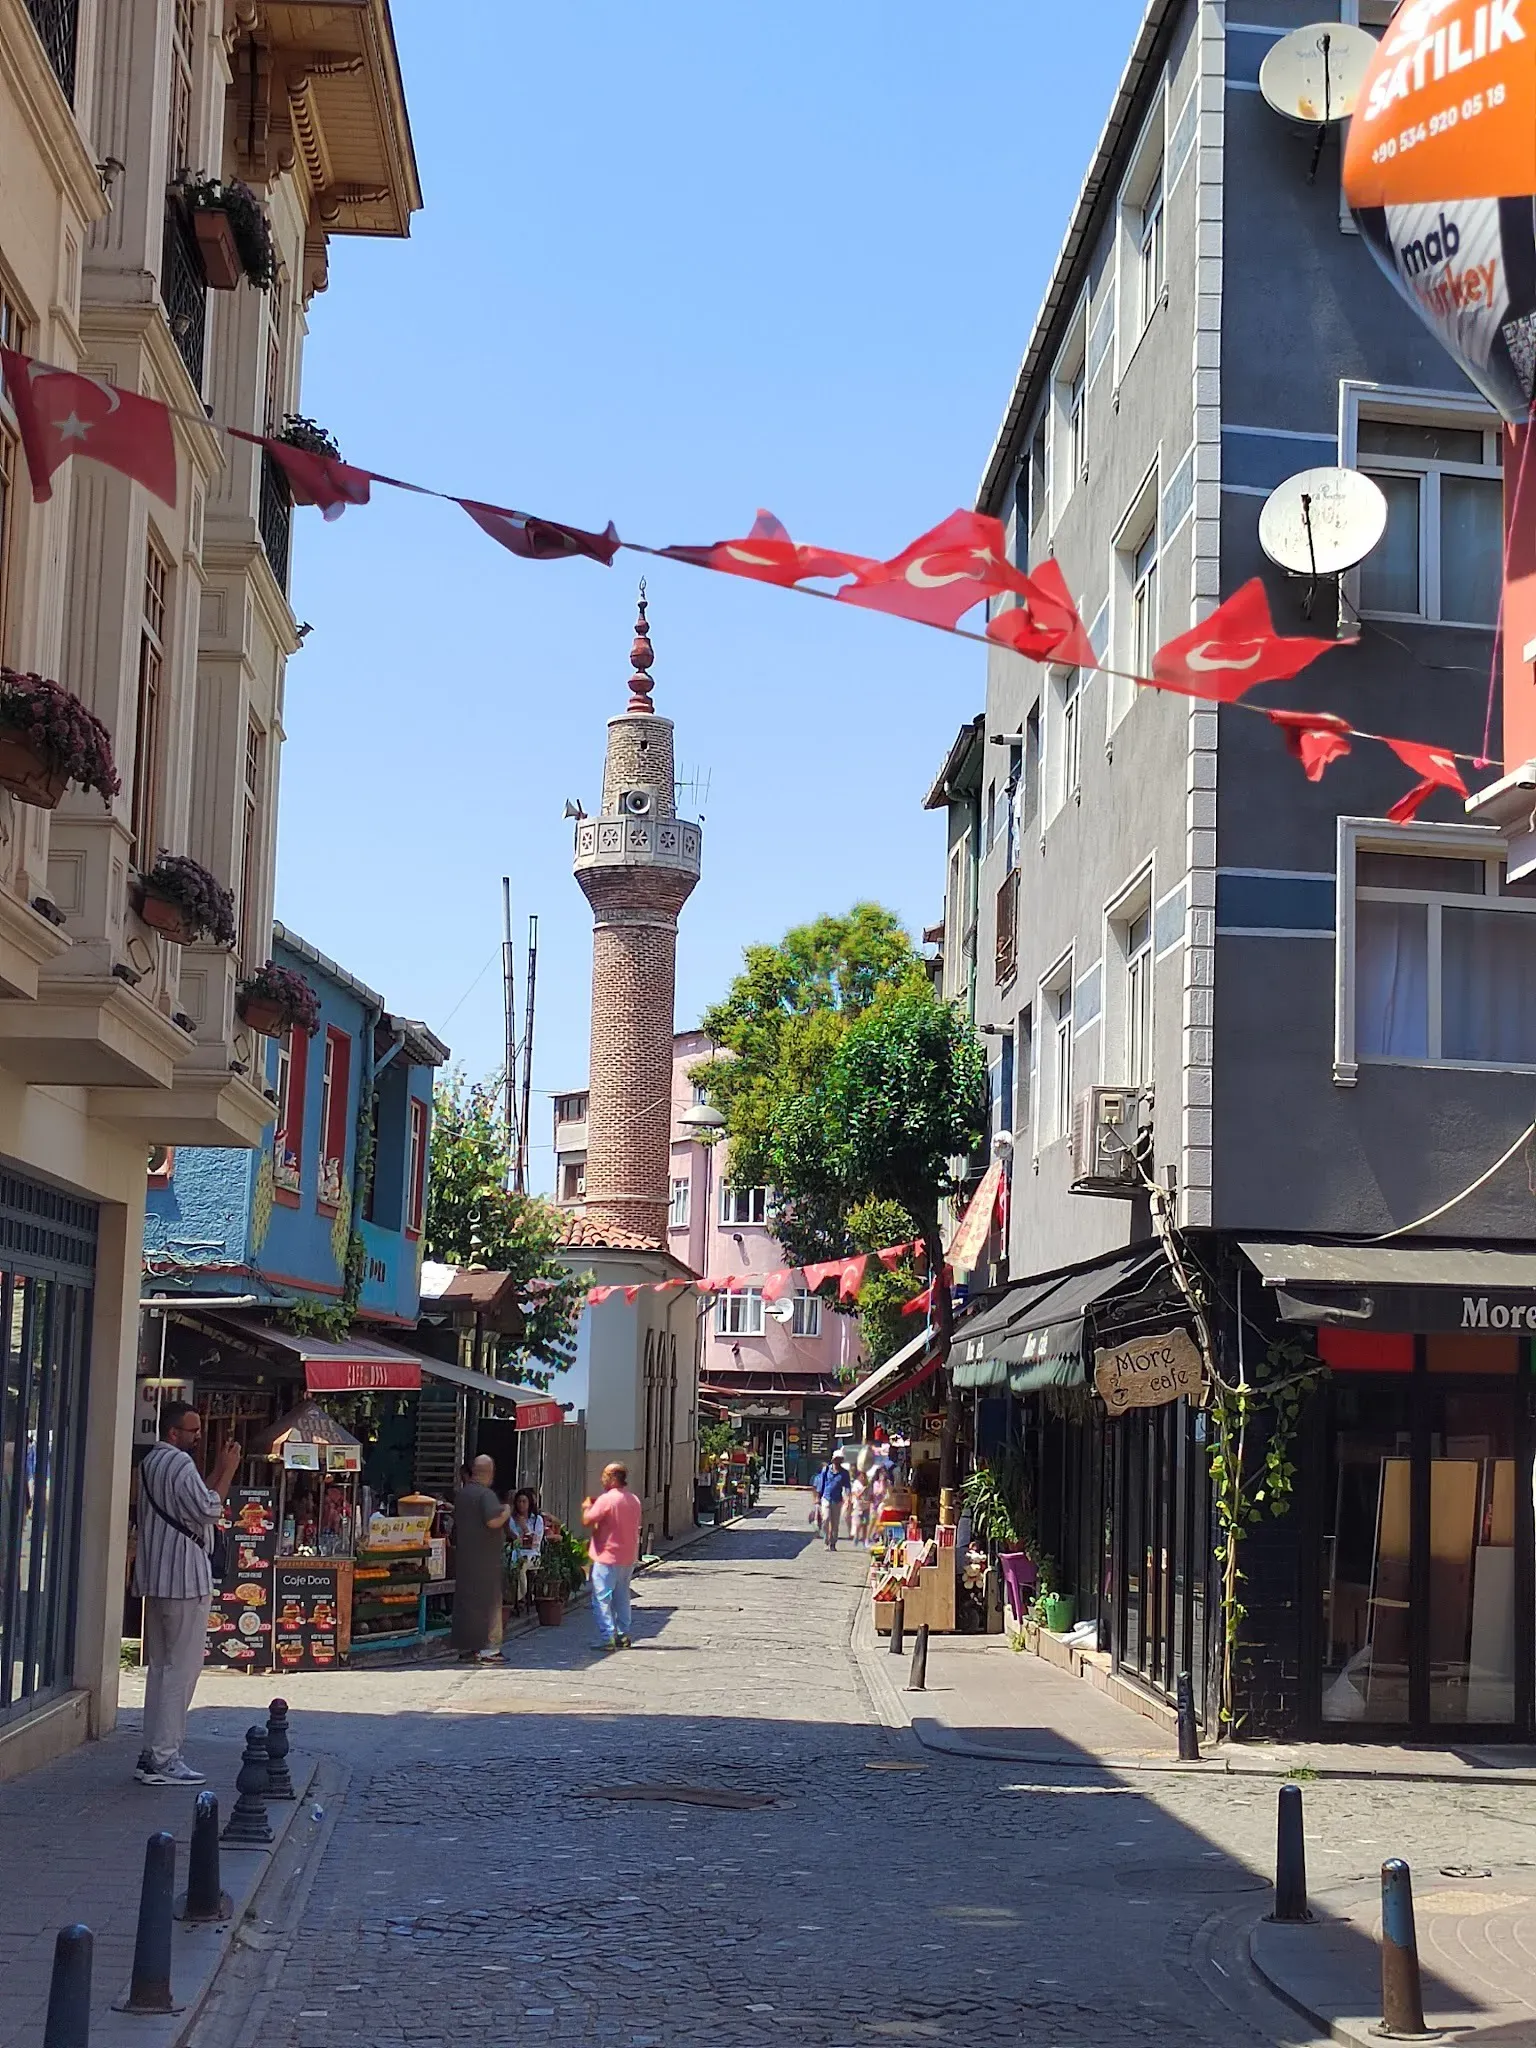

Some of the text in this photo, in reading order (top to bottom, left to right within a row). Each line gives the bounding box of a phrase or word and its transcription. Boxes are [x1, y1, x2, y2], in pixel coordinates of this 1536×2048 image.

[1364, 0, 1526, 121] SATILIK
[1372, 83, 1505, 164] +90 534 920 05 18
[1401, 213, 1459, 277] mab
[1115, 1347, 1175, 1376] More
[1150, 1368, 1189, 1391] cafe
[283, 1575, 330, 1586] Cafe Dora
